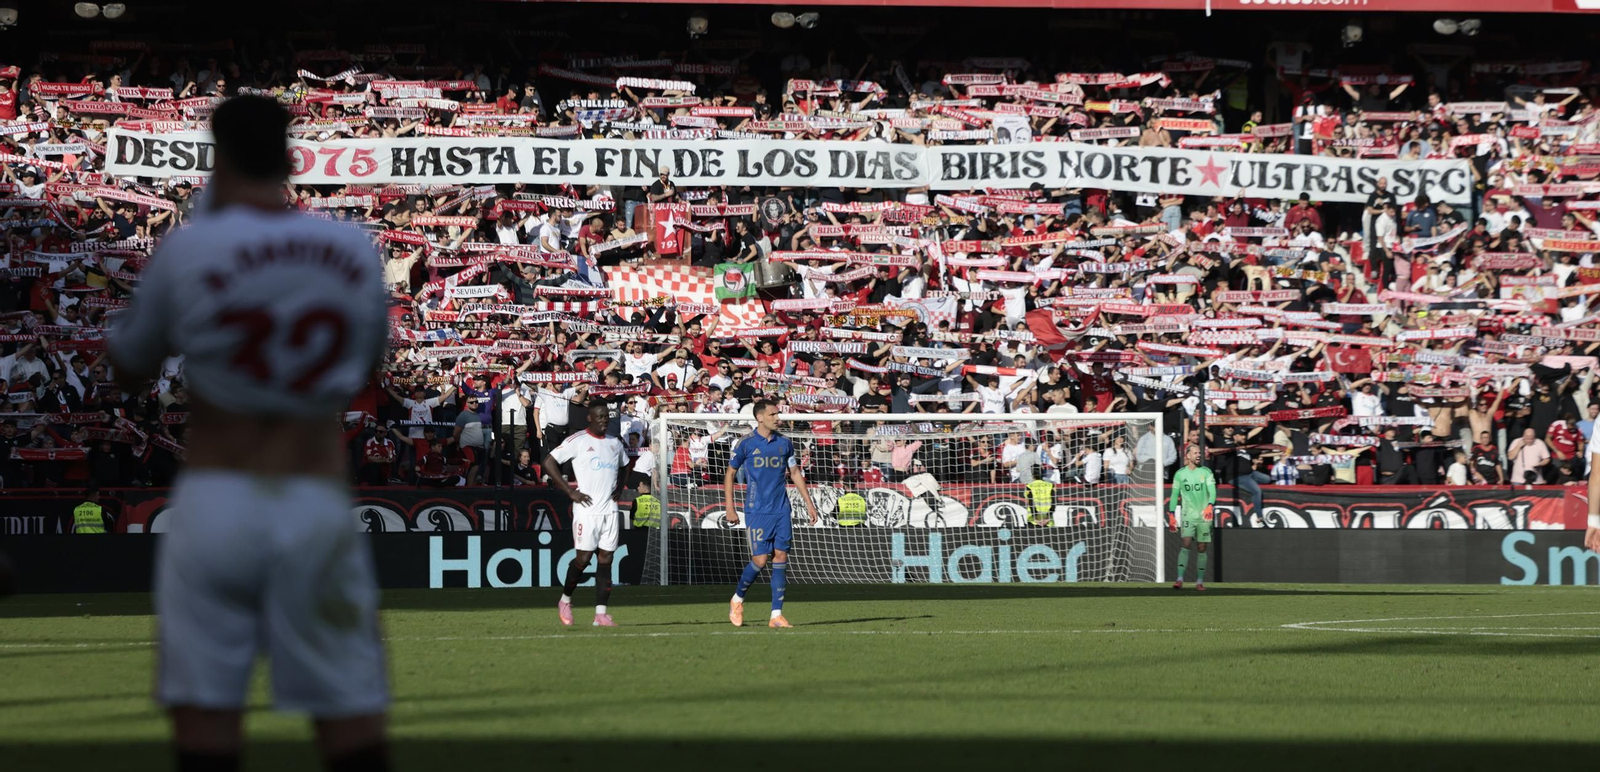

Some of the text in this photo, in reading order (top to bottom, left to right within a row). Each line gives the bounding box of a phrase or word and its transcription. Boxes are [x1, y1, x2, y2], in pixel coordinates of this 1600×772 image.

[41, 84, 62, 92] NUNCA
[70, 84, 90, 92] RINDAS
[975, 86, 995, 95] BIRIS
[568, 99, 625, 108] SEVILLANO
[1059, 95, 1078, 103] BIRIS
[115, 134, 216, 172] DESD
[286, 146, 379, 176] 975
[390, 147, 521, 176] HASTA
[532, 147, 584, 176] EL
[595, 147, 663, 178] FIN
[672, 148, 725, 178] DE
[737, 148, 818, 178] LOS
[828, 149, 920, 180] DIAS
[940, 151, 1047, 181] BIRIS
[1058, 151, 1192, 186] NORTE
[1230, 160, 1379, 195] ULTRAS
[1392, 168, 1466, 196] SFC
[544, 198, 575, 208] BIRIS
[694, 205, 753, 214] BIRIS NORTE
[887, 211, 907, 220] VILLA
[817, 225, 841, 233] BIRIS
[71, 238, 154, 252] BIRIS NORTE
[517, 251, 541, 259] BIRIS
[890, 256, 910, 264] BIRIS
[1225, 291, 1291, 300] BIRIS NORTE
[681, 304, 712, 313] BIRIS
[834, 302, 855, 310] BIRIS
[1501, 334, 1565, 346] ADICTOS SFC
[218, 303, 349, 397] 32
[791, 342, 820, 352] BIRIS
[428, 348, 474, 356] SUPERCOPA
[527, 372, 588, 382] BIRIS NORTE
[167, 414, 184, 422] SEV
[753, 456, 783, 468] DIGI
[1185, 484, 1203, 492] DIGI
[577, 523, 583, 536] 9
[752, 528, 764, 542] 12
[429, 531, 629, 589] Haier
[891, 528, 1087, 583] Haier
